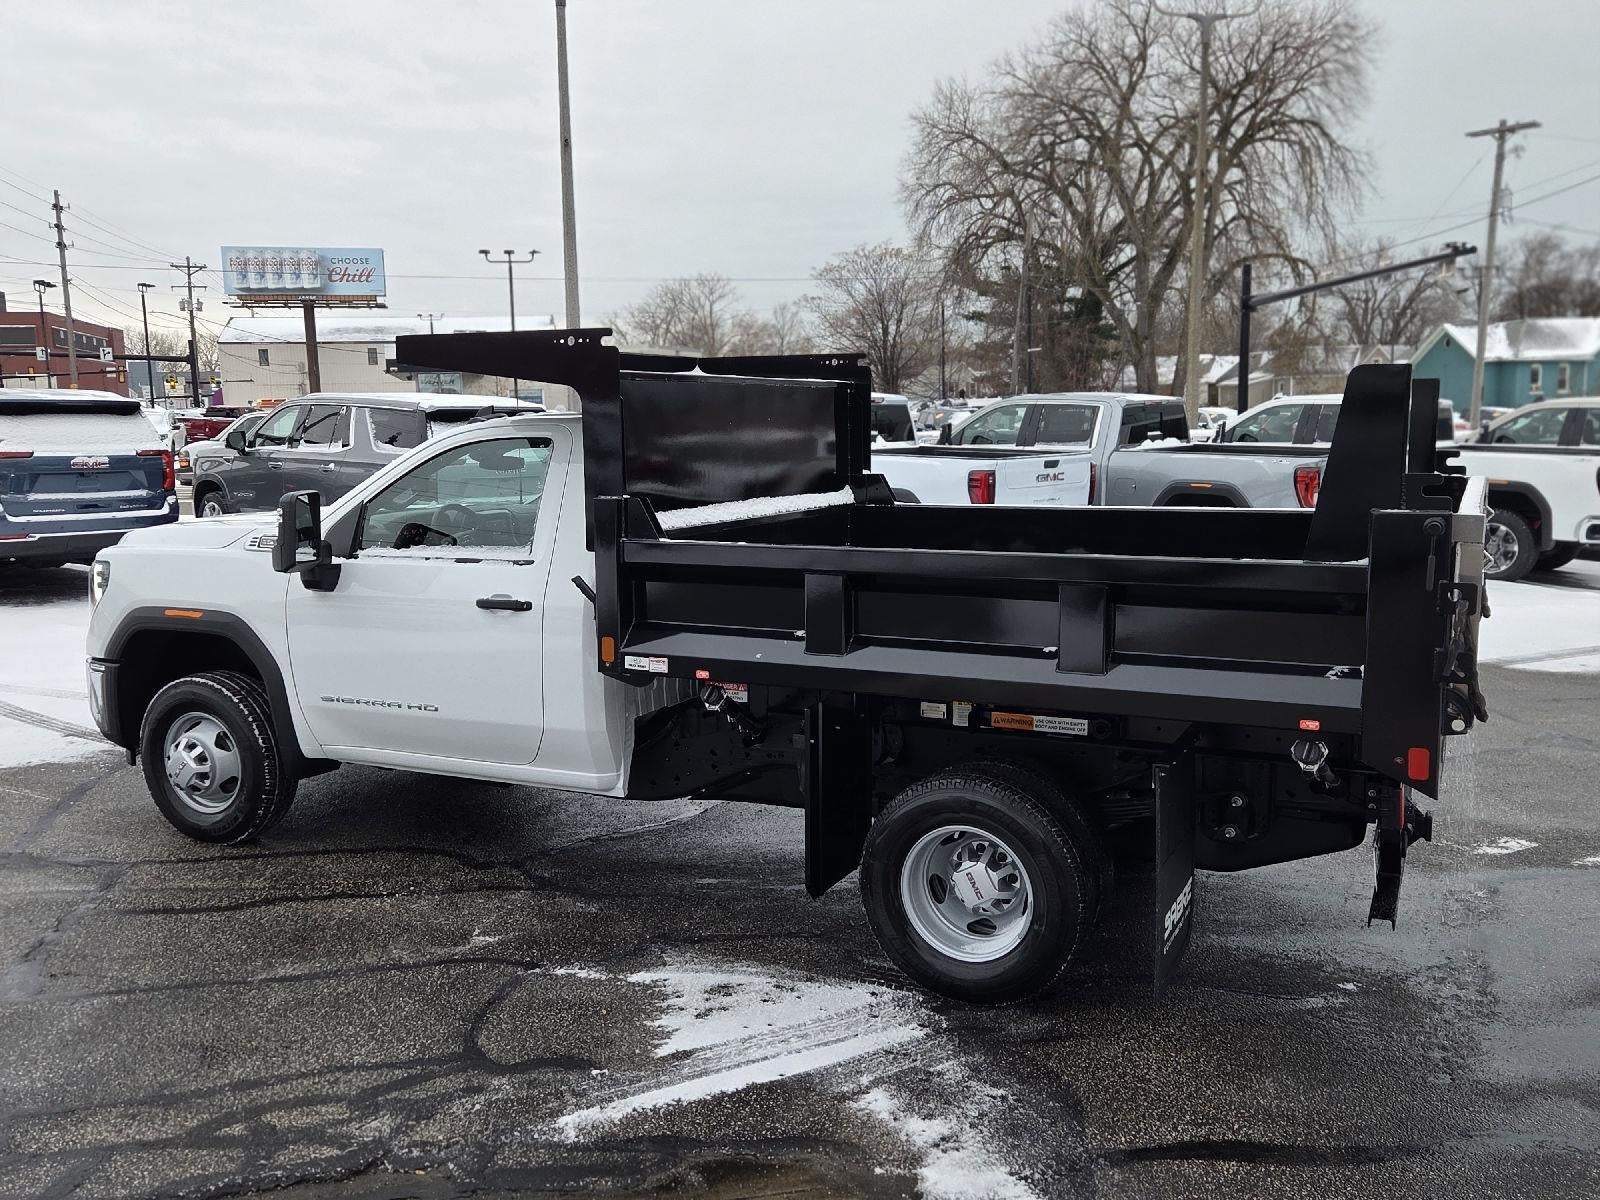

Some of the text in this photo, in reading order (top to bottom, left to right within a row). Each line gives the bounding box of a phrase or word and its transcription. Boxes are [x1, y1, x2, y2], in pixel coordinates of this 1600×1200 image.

[330, 257, 370, 265] CHOOSE
[327, 266, 376, 284] Chill
[1036, 472, 1065, 482] GMC
[320, 695, 439, 713] SIERRA HD
[1000, 717, 1033, 727] WARNING
[966, 871, 984, 900] GMC
